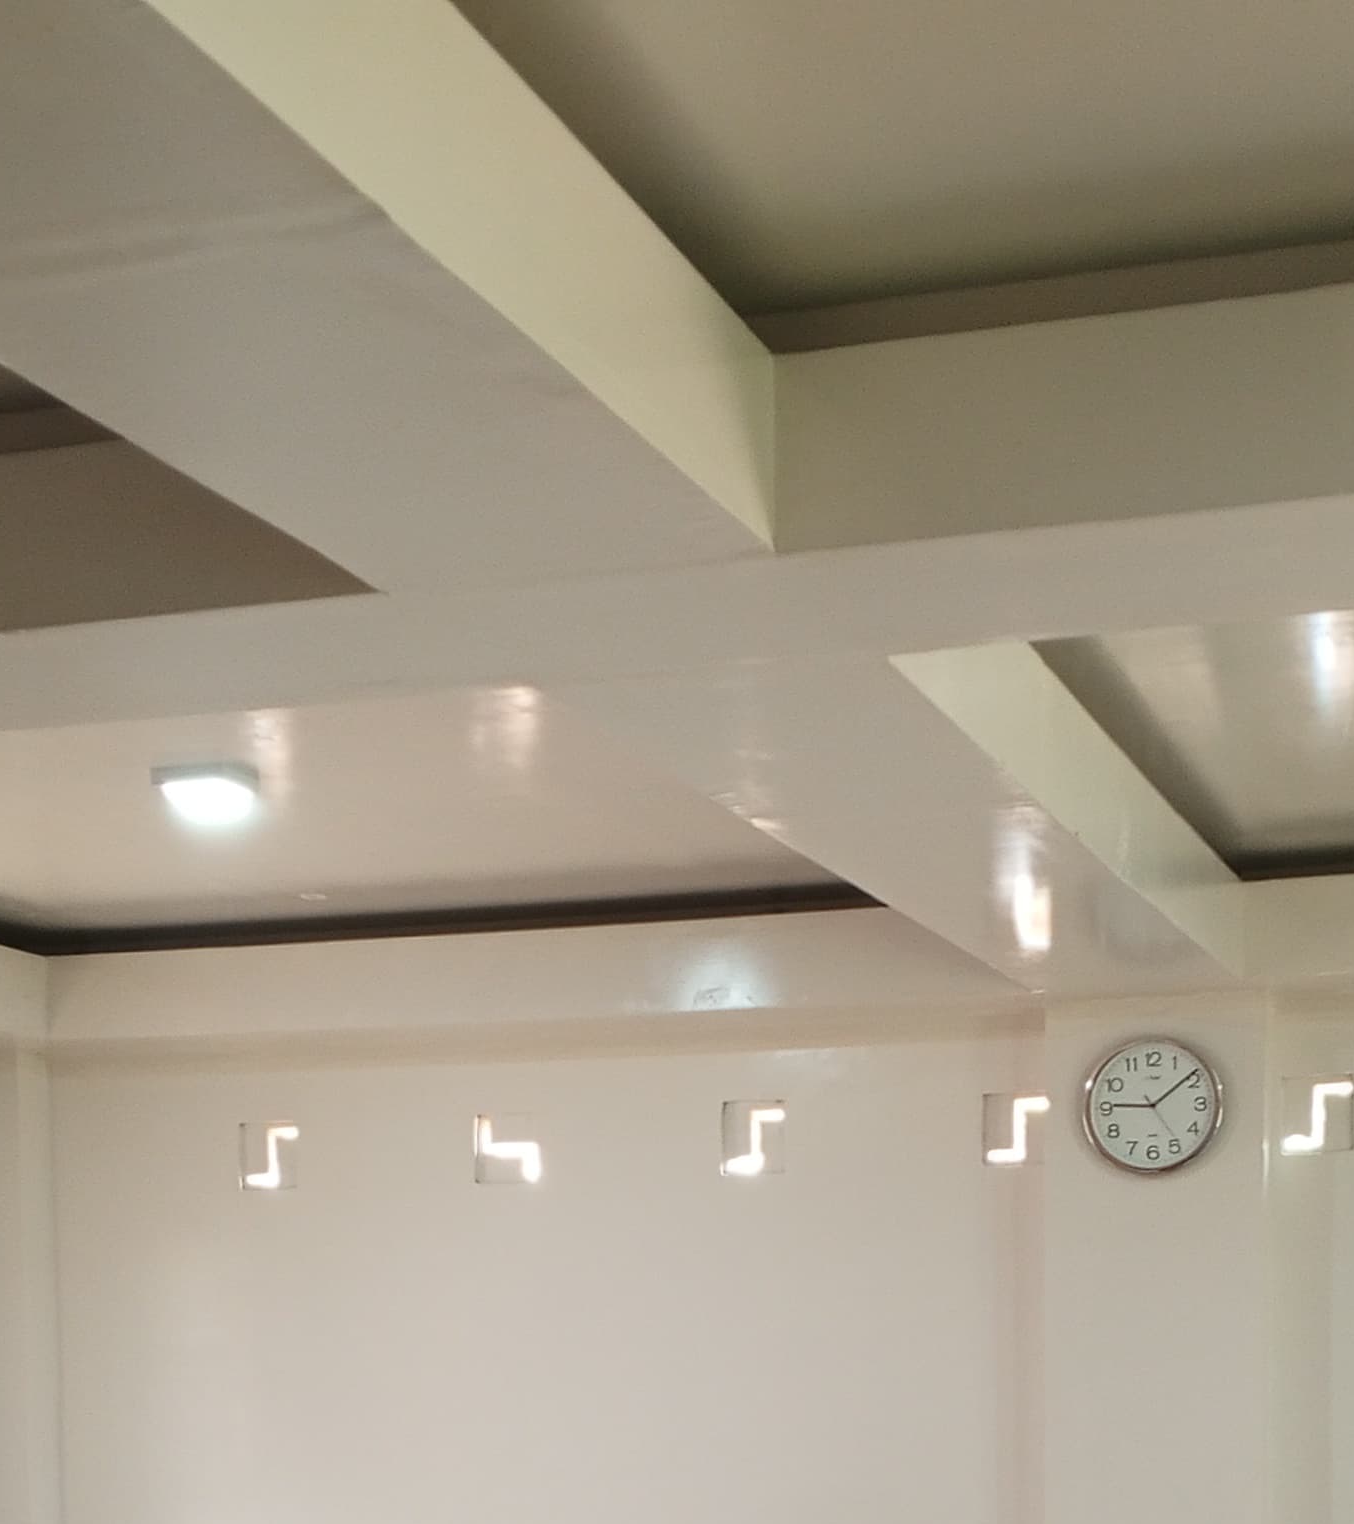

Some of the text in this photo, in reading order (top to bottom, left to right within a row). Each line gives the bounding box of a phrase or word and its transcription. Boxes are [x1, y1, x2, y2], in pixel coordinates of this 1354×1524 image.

[1125, 1057, 1137, 1072] 11
[1145, 1051, 1162, 1067] 12
[1172, 1055, 1177, 1070] 1
[1106, 1077, 1124, 1093] 10
[1186, 1072, 1201, 1089] 2
[1099, 1101, 1113, 1117] 9
[1194, 1096, 1207, 1112] 3
[1107, 1123, 1120, 1139] 8
[1186, 1121, 1199, 1136] 4
[1126, 1141, 1139, 1156] 7
[1146, 1145, 1160, 1160] 6
[1168, 1138, 1181, 1154] 5
